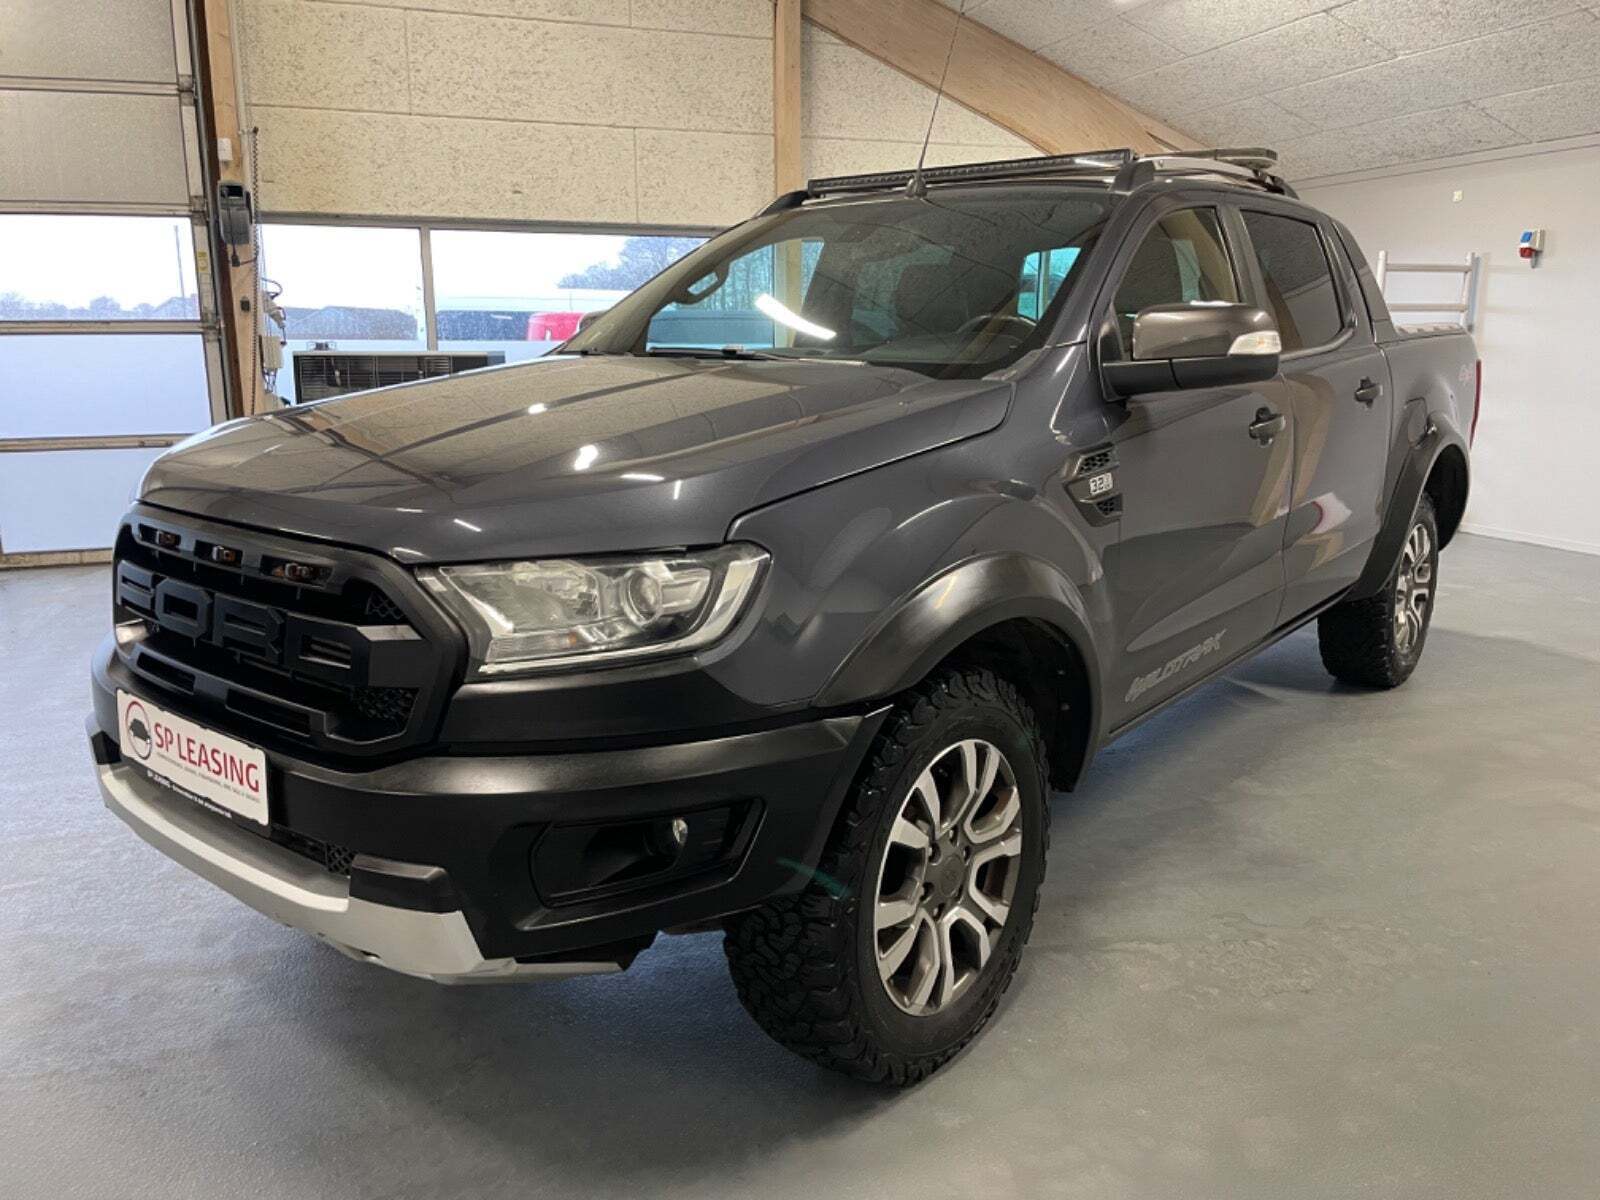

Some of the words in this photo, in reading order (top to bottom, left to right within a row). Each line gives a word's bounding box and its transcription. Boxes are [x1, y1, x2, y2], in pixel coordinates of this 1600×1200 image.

[117, 559, 369, 692] FORD
[153, 722, 174, 752] SP
[177, 732, 260, 793] LEASING
